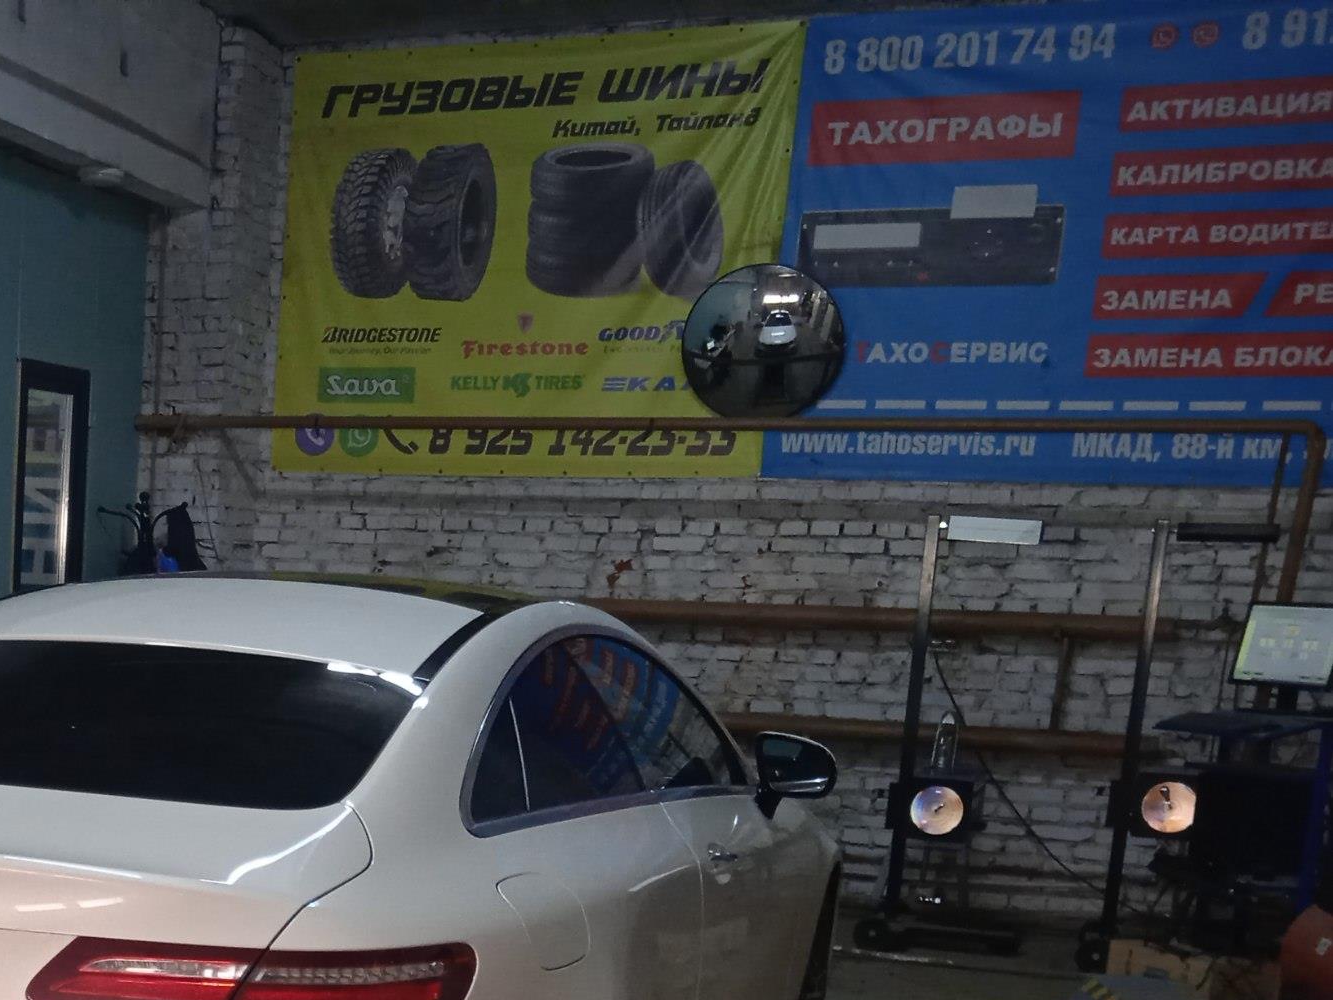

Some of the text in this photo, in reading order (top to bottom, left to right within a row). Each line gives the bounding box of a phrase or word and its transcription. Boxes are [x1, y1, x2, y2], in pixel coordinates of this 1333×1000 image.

[1242, 8, 1333, 50] 8 91
[824, 23, 1116, 75] 8 800 201 74 94
[321, 57, 771, 118] ГРУЗОВЫЕ ШИНЫ
[1127, 90, 1333, 122] АКТИВАЦИЯ
[552, 115, 641, 138] Китай,
[827, 112, 1063, 146] ТАХОГРАФЫ
[1117, 157, 1333, 187] КАЛИБРОВКА
[1110, 220, 1333, 246] КАРТА ВОДИТЕ
[1100, 289, 1232, 310] ЗАМЕНА
[322, 326, 443, 343] BRIDGESTONE
[462, 340, 589, 359] Firestone
[856, 342, 1048, 364] ТАХОСЕРВИС
[1093, 347, 1224, 368] ЗАМЕНА
[326, 375, 400, 396] Sava
[450, 375, 501, 390] KELLY
[535, 375, 583, 390] TIRES
[781, 431, 1037, 457] www.tahoservis.ru
[1072, 433, 1161, 463] МКАД,
